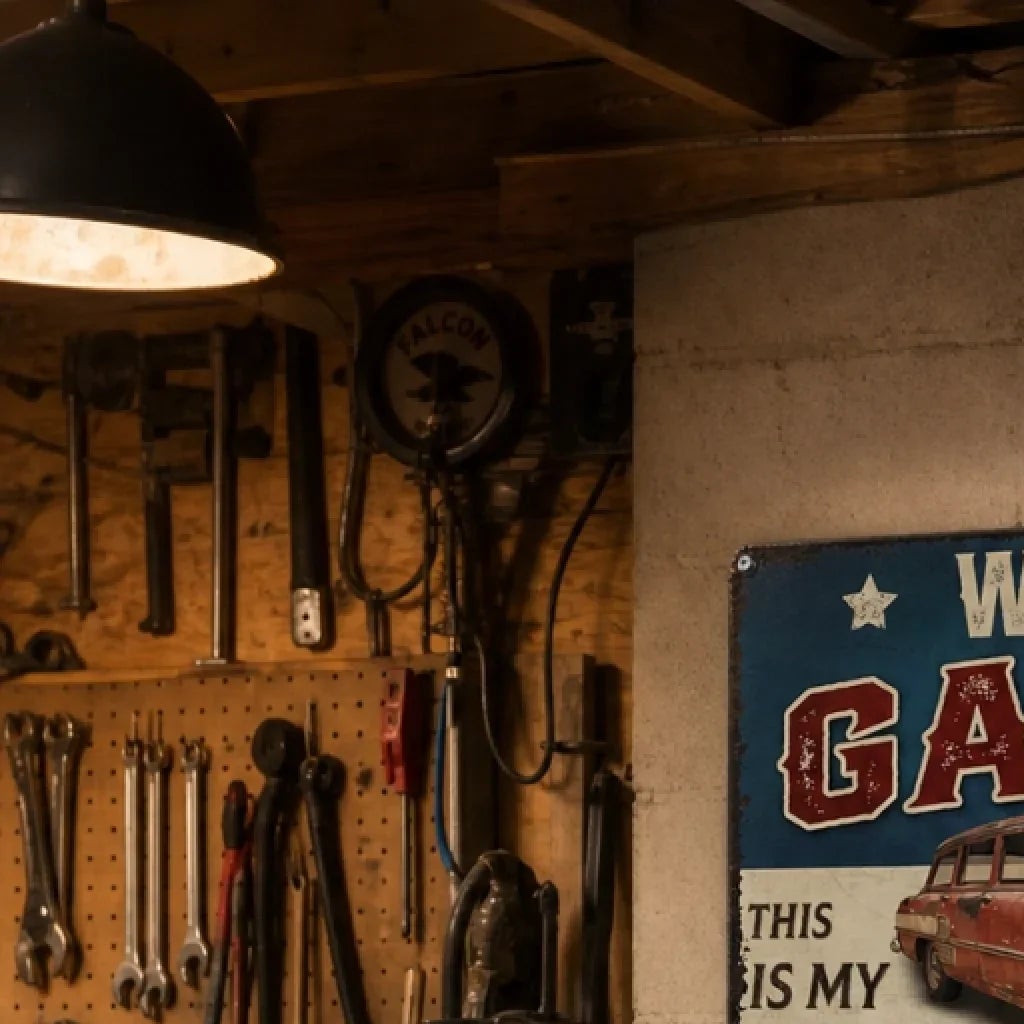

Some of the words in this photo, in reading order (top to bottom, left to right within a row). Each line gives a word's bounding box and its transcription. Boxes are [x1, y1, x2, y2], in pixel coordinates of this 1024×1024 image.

[398, 311, 490, 356] FALCON
[748, 901, 833, 939] THIS
[749, 962, 794, 1010] IS
[806, 962, 890, 1009] MY
